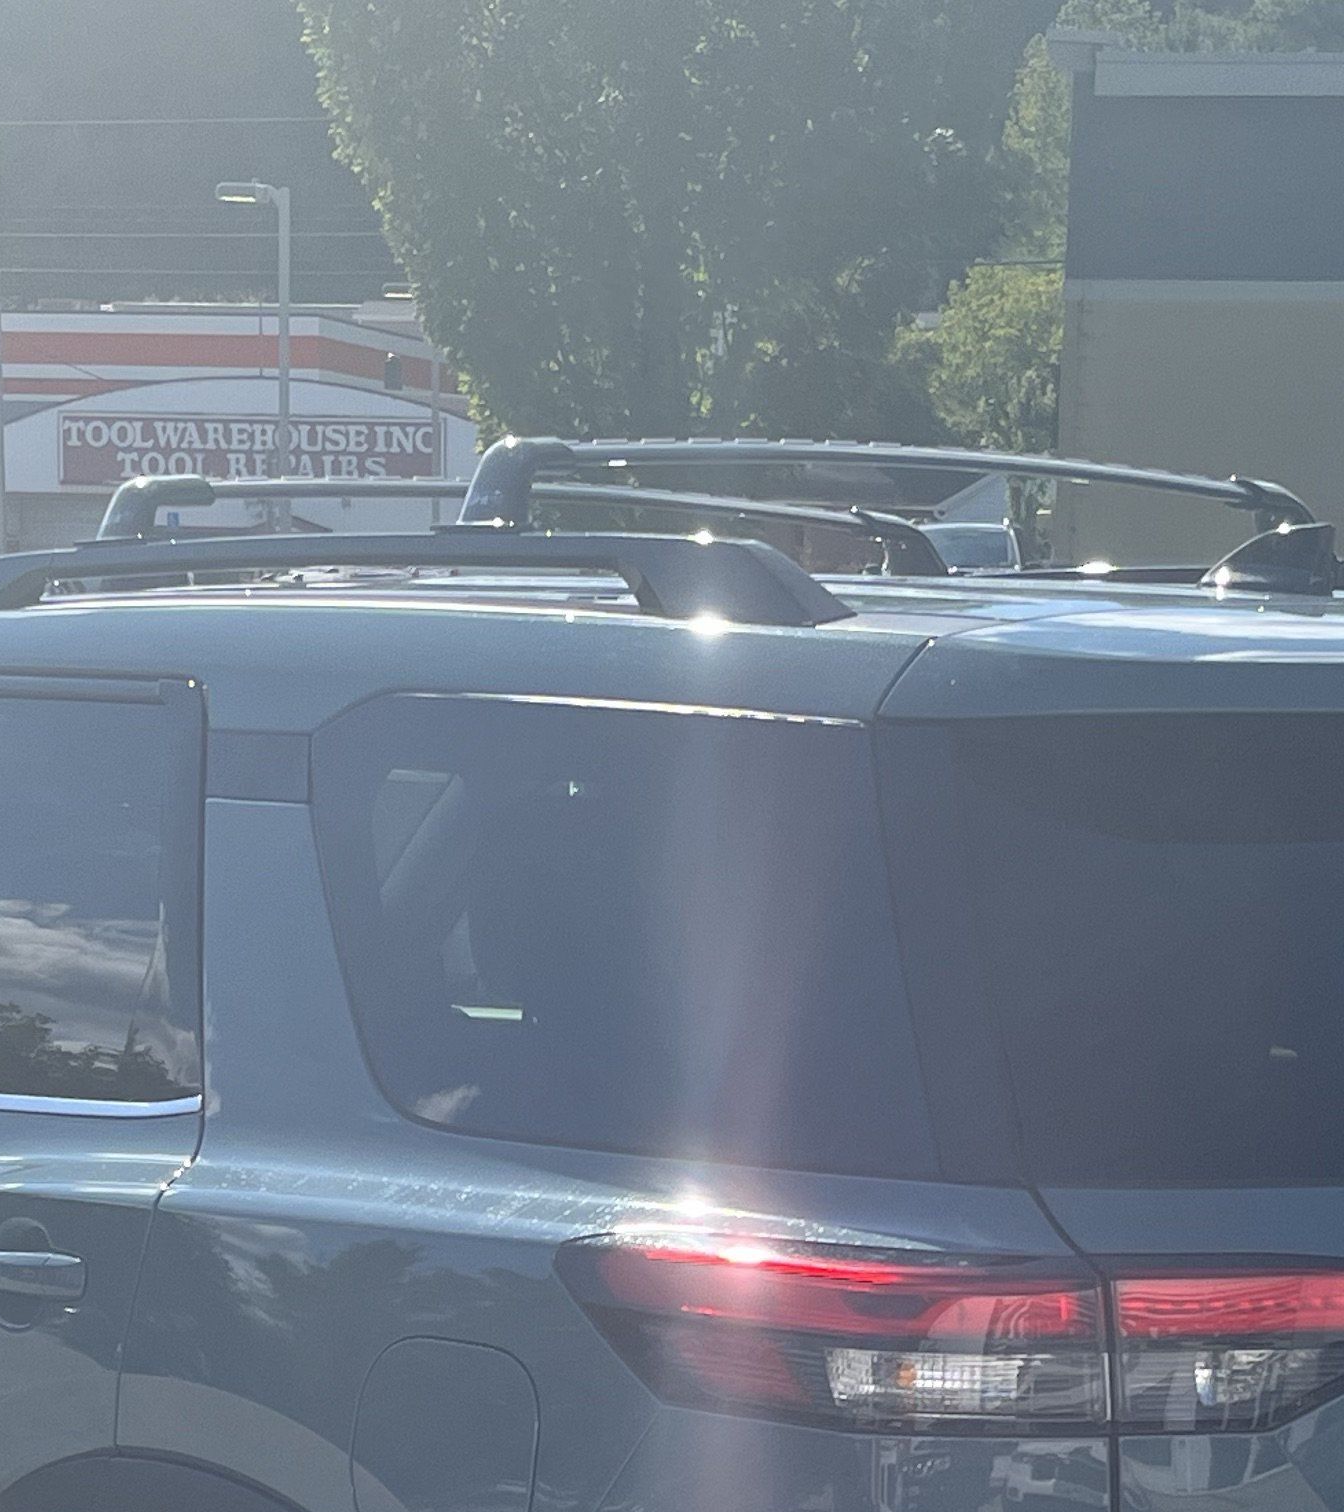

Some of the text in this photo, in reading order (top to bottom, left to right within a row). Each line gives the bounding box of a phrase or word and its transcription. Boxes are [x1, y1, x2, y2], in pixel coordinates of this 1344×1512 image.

[63, 419, 434, 454] TOOL WAREHOUSE INC
[116, 451, 211, 478] TOOL
